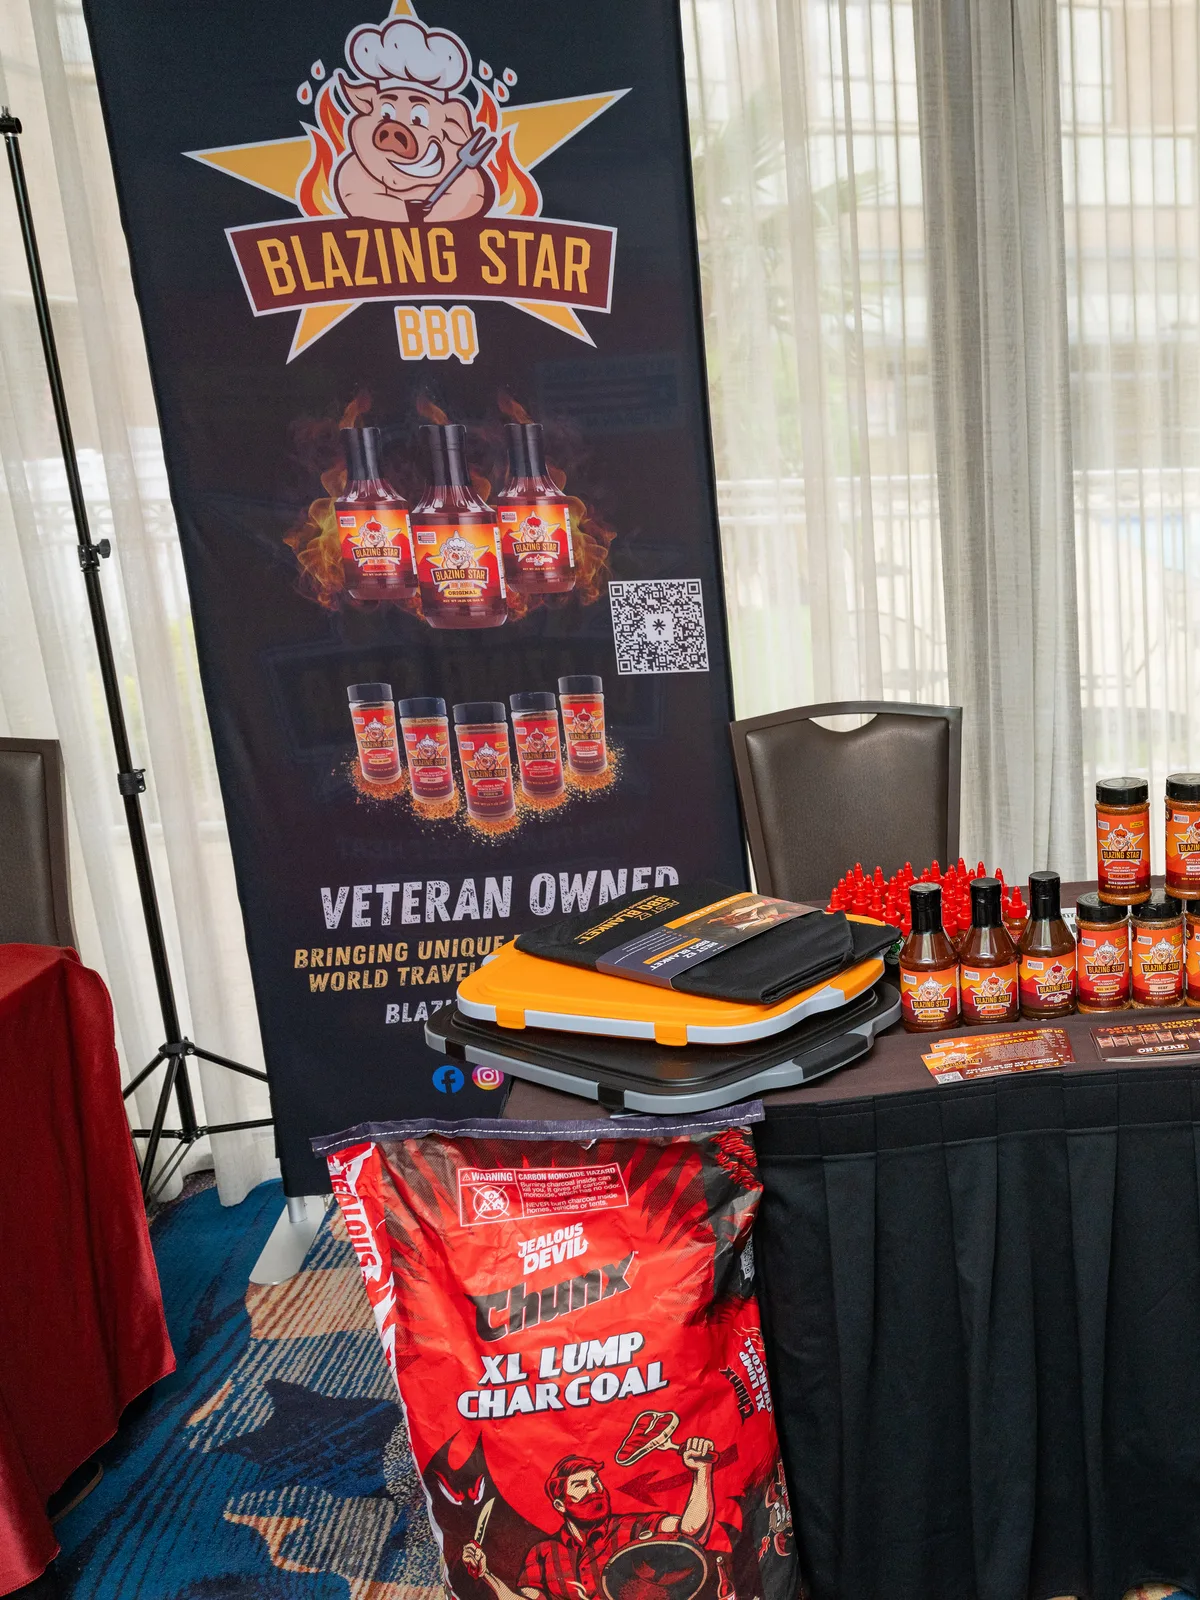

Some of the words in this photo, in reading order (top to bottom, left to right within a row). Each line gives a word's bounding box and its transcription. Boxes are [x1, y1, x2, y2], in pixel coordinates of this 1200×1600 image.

[256, 227, 458, 296] BLAZING
[479, 231, 592, 294] STAR
[395, 306, 479, 363] BBQ
[435, 569, 466, 581] BLAZING
[468, 570, 486, 580] STAR
[320, 875, 513, 930] VETERAN
[636, 896, 671, 911] BBQ
[294, 942, 409, 969] BRINGING
[309, 966, 388, 993] WORLD
[1098, 1025, 1134, 1033] TASTE
[1155, 1044, 1186, 1052] YEAH
[471, 1172, 513, 1182] WARNING
[518, 1173, 547, 1181] CARBON
[548, 1171, 585, 1180] MONOXIDE
[586, 1167, 616, 1178] HAZARD
[549, 1178, 576, 1187] charcoal
[577, 1177, 597, 1185] inside
[552, 1184, 571, 1192] gives
[582, 1180, 607, 1188] carbon
[604, 1182, 621, 1191] odor.
[553, 1203, 579, 1212] vehicles
[589, 1199, 608, 1208] tents.
[568, 1196, 596, 1205] charcoal
[597, 1192, 618, 1201] inside
[518, 1222, 584, 1259] JEALOUS
[523, 1237, 590, 1276] DEVIL
[467, 1253, 636, 1343] Chunx
[477, 1352, 529, 1385] XL
[538, 1331, 646, 1380] LUMP
[739, 1350, 762, 1390] LUMP
[457, 1362, 670, 1420] CHARCOAL
[755, 1393, 766, 1413] XL
